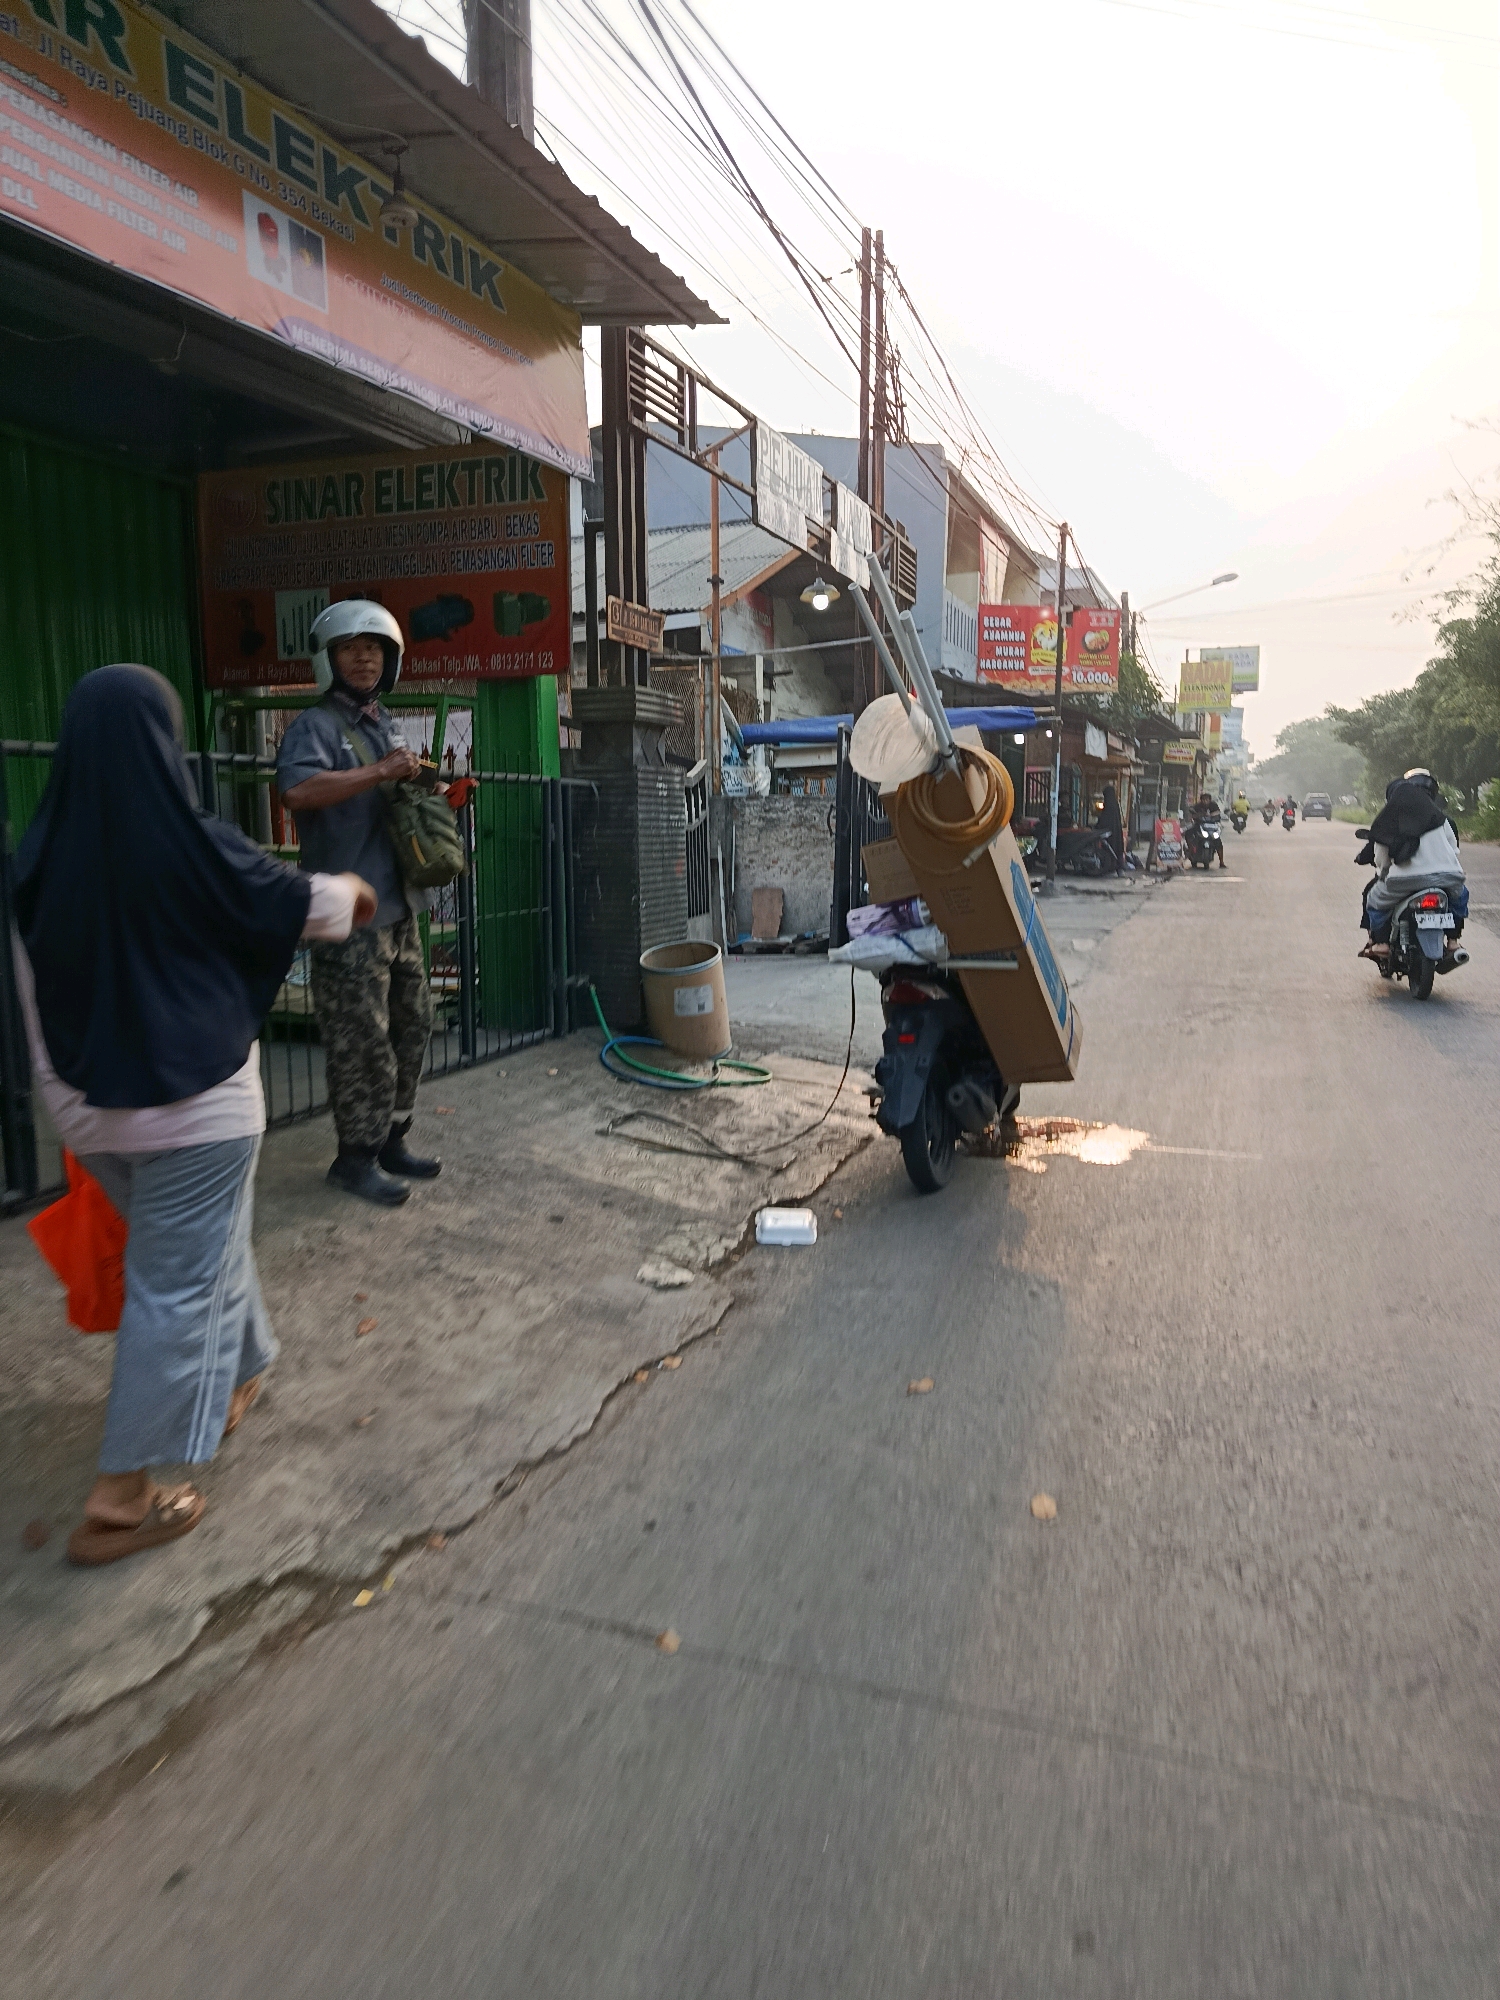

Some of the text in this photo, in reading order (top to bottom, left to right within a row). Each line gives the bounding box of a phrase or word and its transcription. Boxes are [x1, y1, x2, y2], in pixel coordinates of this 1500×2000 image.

[60, 44, 110, 92] Raya
[114, 79, 191, 147] Pejuang
[193, 127, 230, 166] Blok
[234, 152, 247, 177] G
[311, 200, 357, 243] Bekasi
[2, 175, 39, 211] DLL
[164, 33, 508, 314] ELEKTRIK
[173, 181, 200, 209] AIR
[47, 167, 104, 213] MEDIA
[106, 198, 159, 240] FILTER
[161, 226, 188, 255] AIR
[292, 325, 357, 368] MENERIMA
[358, 355, 399, 387] SERVIS
[457, 403, 468, 419] DI
[265, 472, 365, 525] SINAR
[374, 454, 547, 517] ELEKTRIK
[384, 521, 415, 549] MESIN
[416, 519, 449, 546] POMPA
[451, 517, 469, 544] AIR
[469, 514, 498, 541] BARU
[505, 510, 540, 539] BEKAS
[384, 550, 439, 579] PANGGILAN
[440, 549, 449, 574] &
[450, 545, 518, 574] PEMASANGAN
[519, 540, 555, 569] FILTER
[267, 663, 288, 682] Raya
[289, 662, 316, 682] Pejua
[411, 656, 441, 674] Bekasi
[490, 652, 512, 671] 0813
[513, 651, 535, 671] 2171
[537, 650, 554, 669] 123
